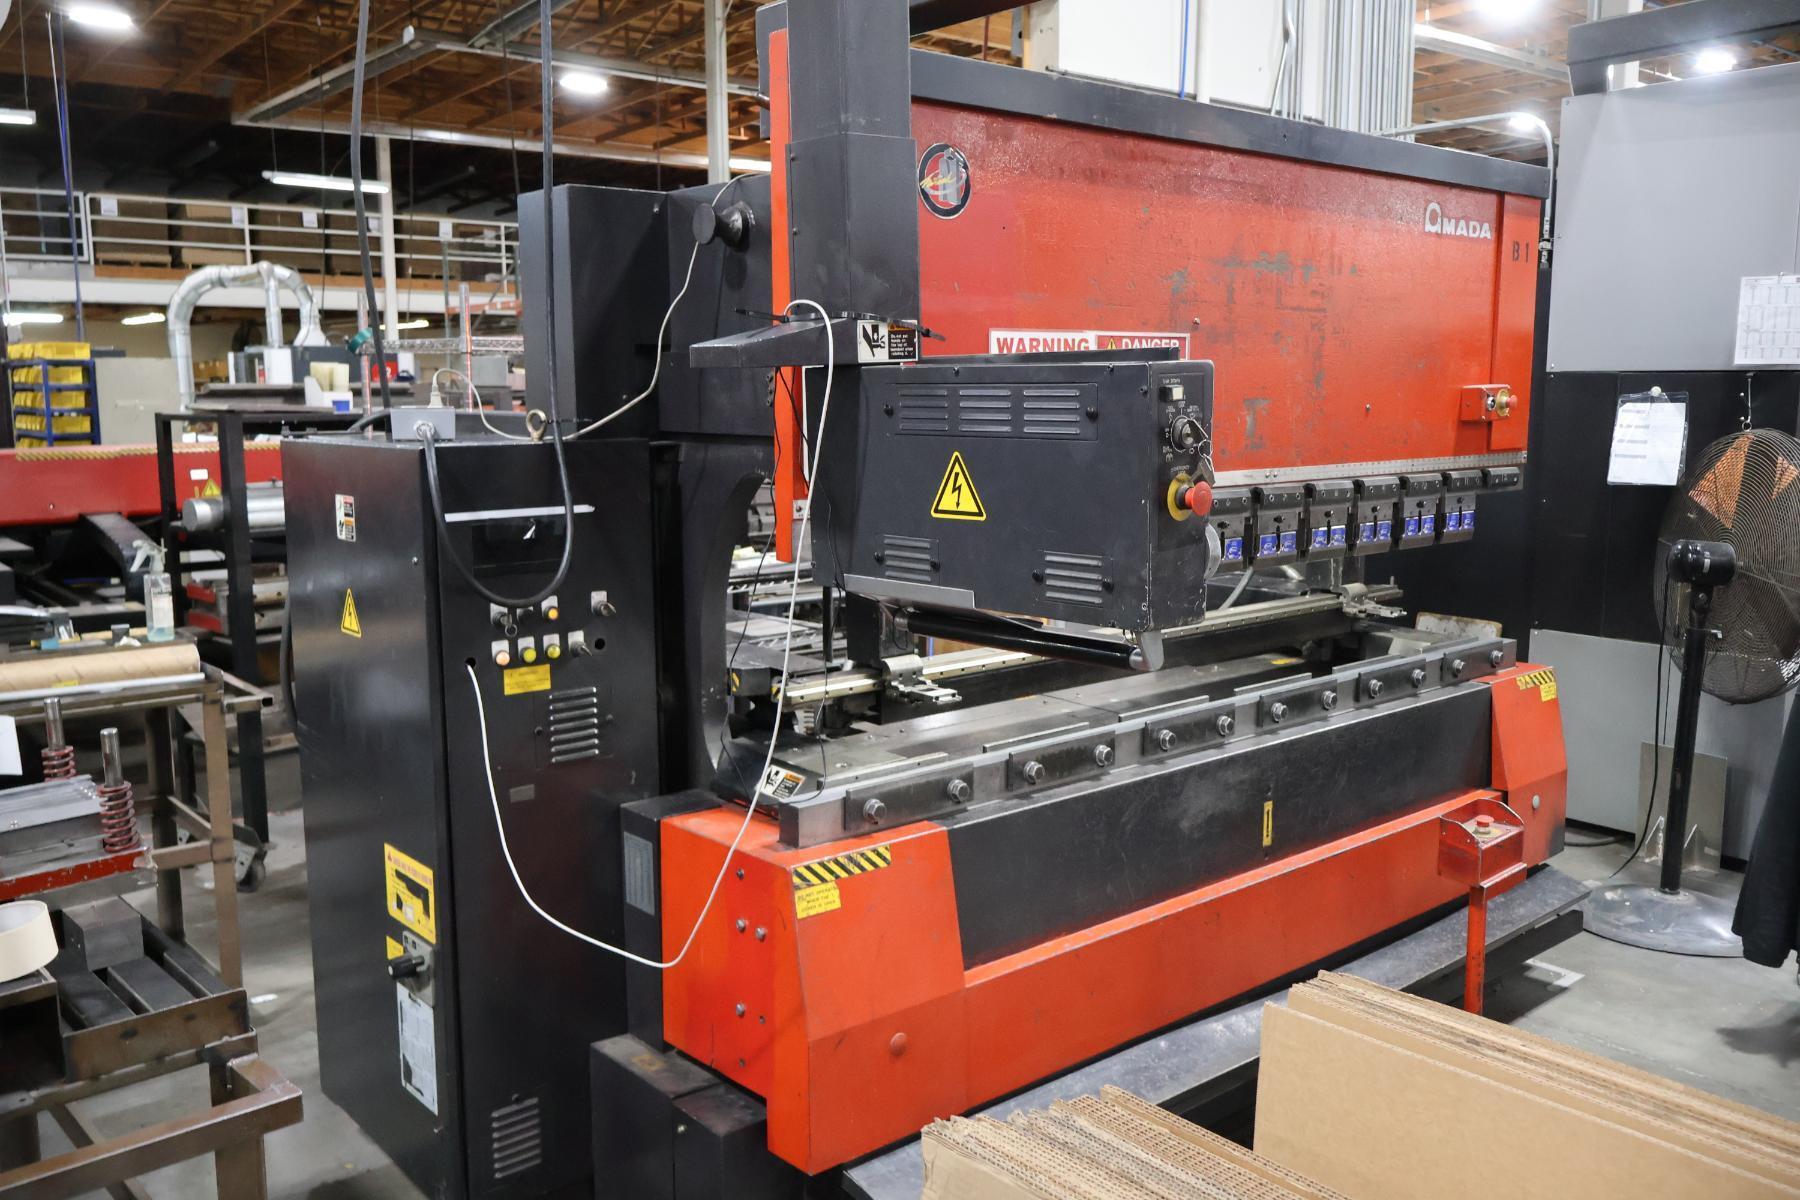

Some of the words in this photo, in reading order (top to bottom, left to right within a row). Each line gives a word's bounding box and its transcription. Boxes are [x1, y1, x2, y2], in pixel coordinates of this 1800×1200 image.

[1424, 202, 1491, 239] AMADA
[1512, 241, 1520, 262] B
[996, 337, 1090, 353] WARNING
